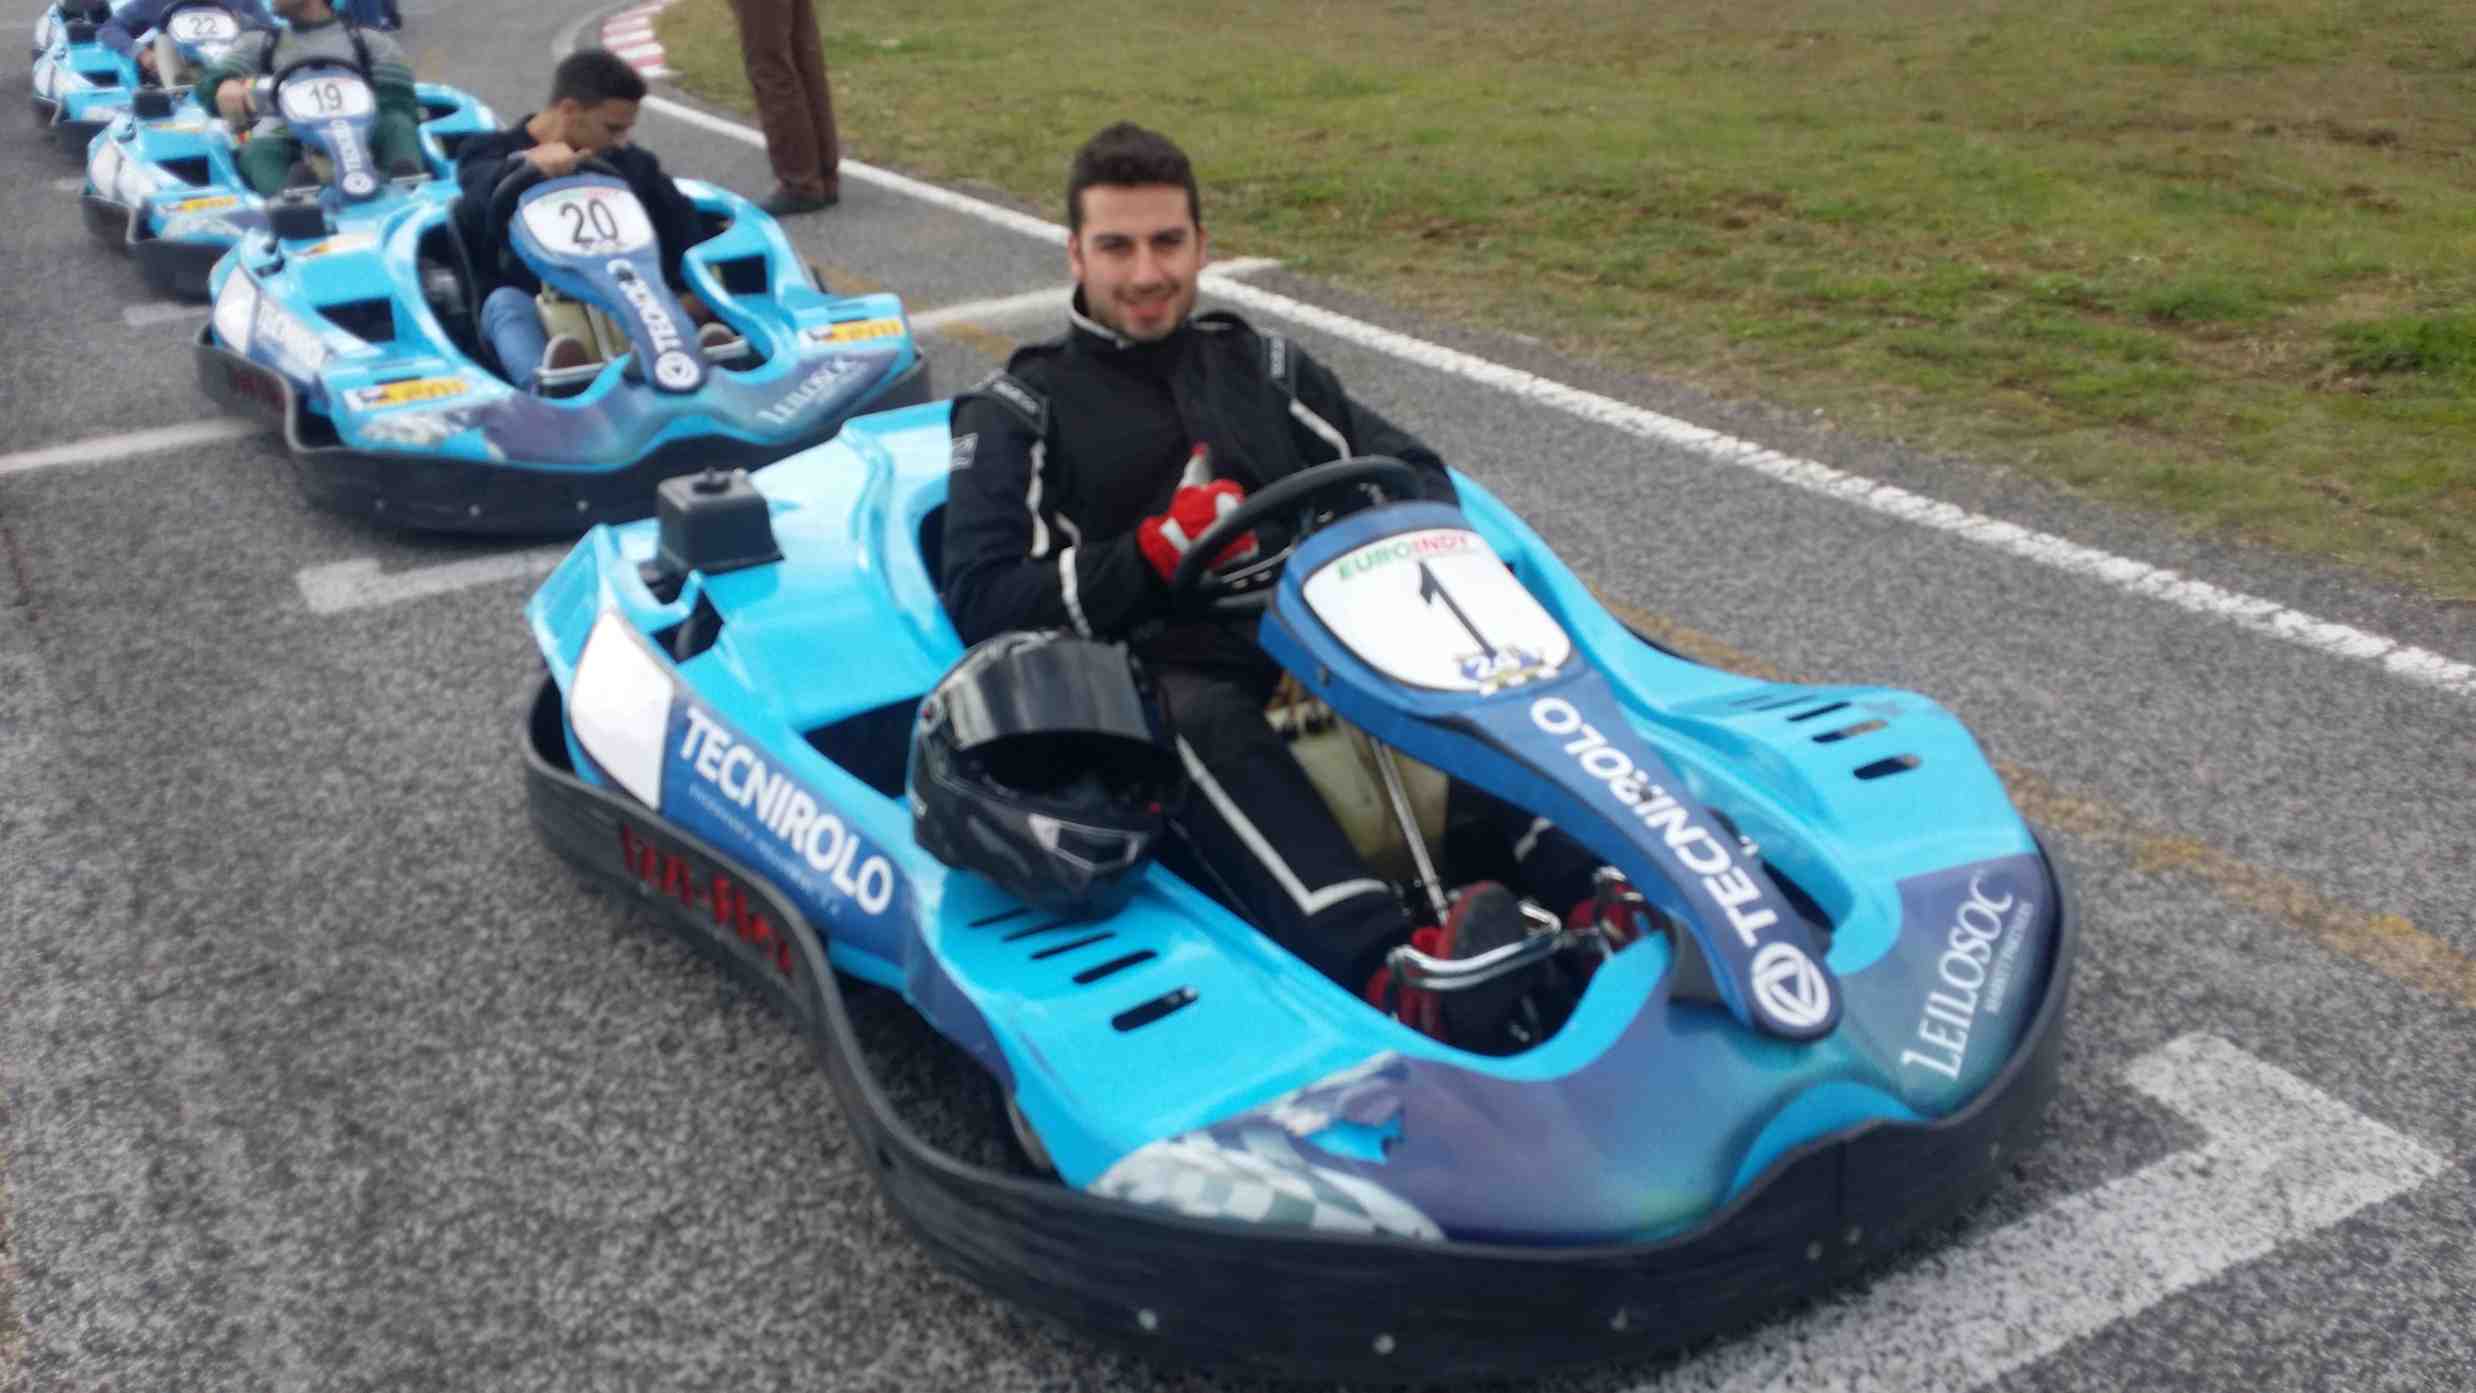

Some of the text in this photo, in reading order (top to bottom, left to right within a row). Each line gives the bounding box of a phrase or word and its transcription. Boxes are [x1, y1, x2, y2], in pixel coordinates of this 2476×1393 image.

[190, 16, 217, 35] 22
[310, 82, 343, 112] 19
[561, 198, 618, 243] 20
[1418, 560, 1497, 661] 1
[680, 706, 893, 915] TECNIROLO
[1902, 868, 2013, 1078] LEILOSOC
